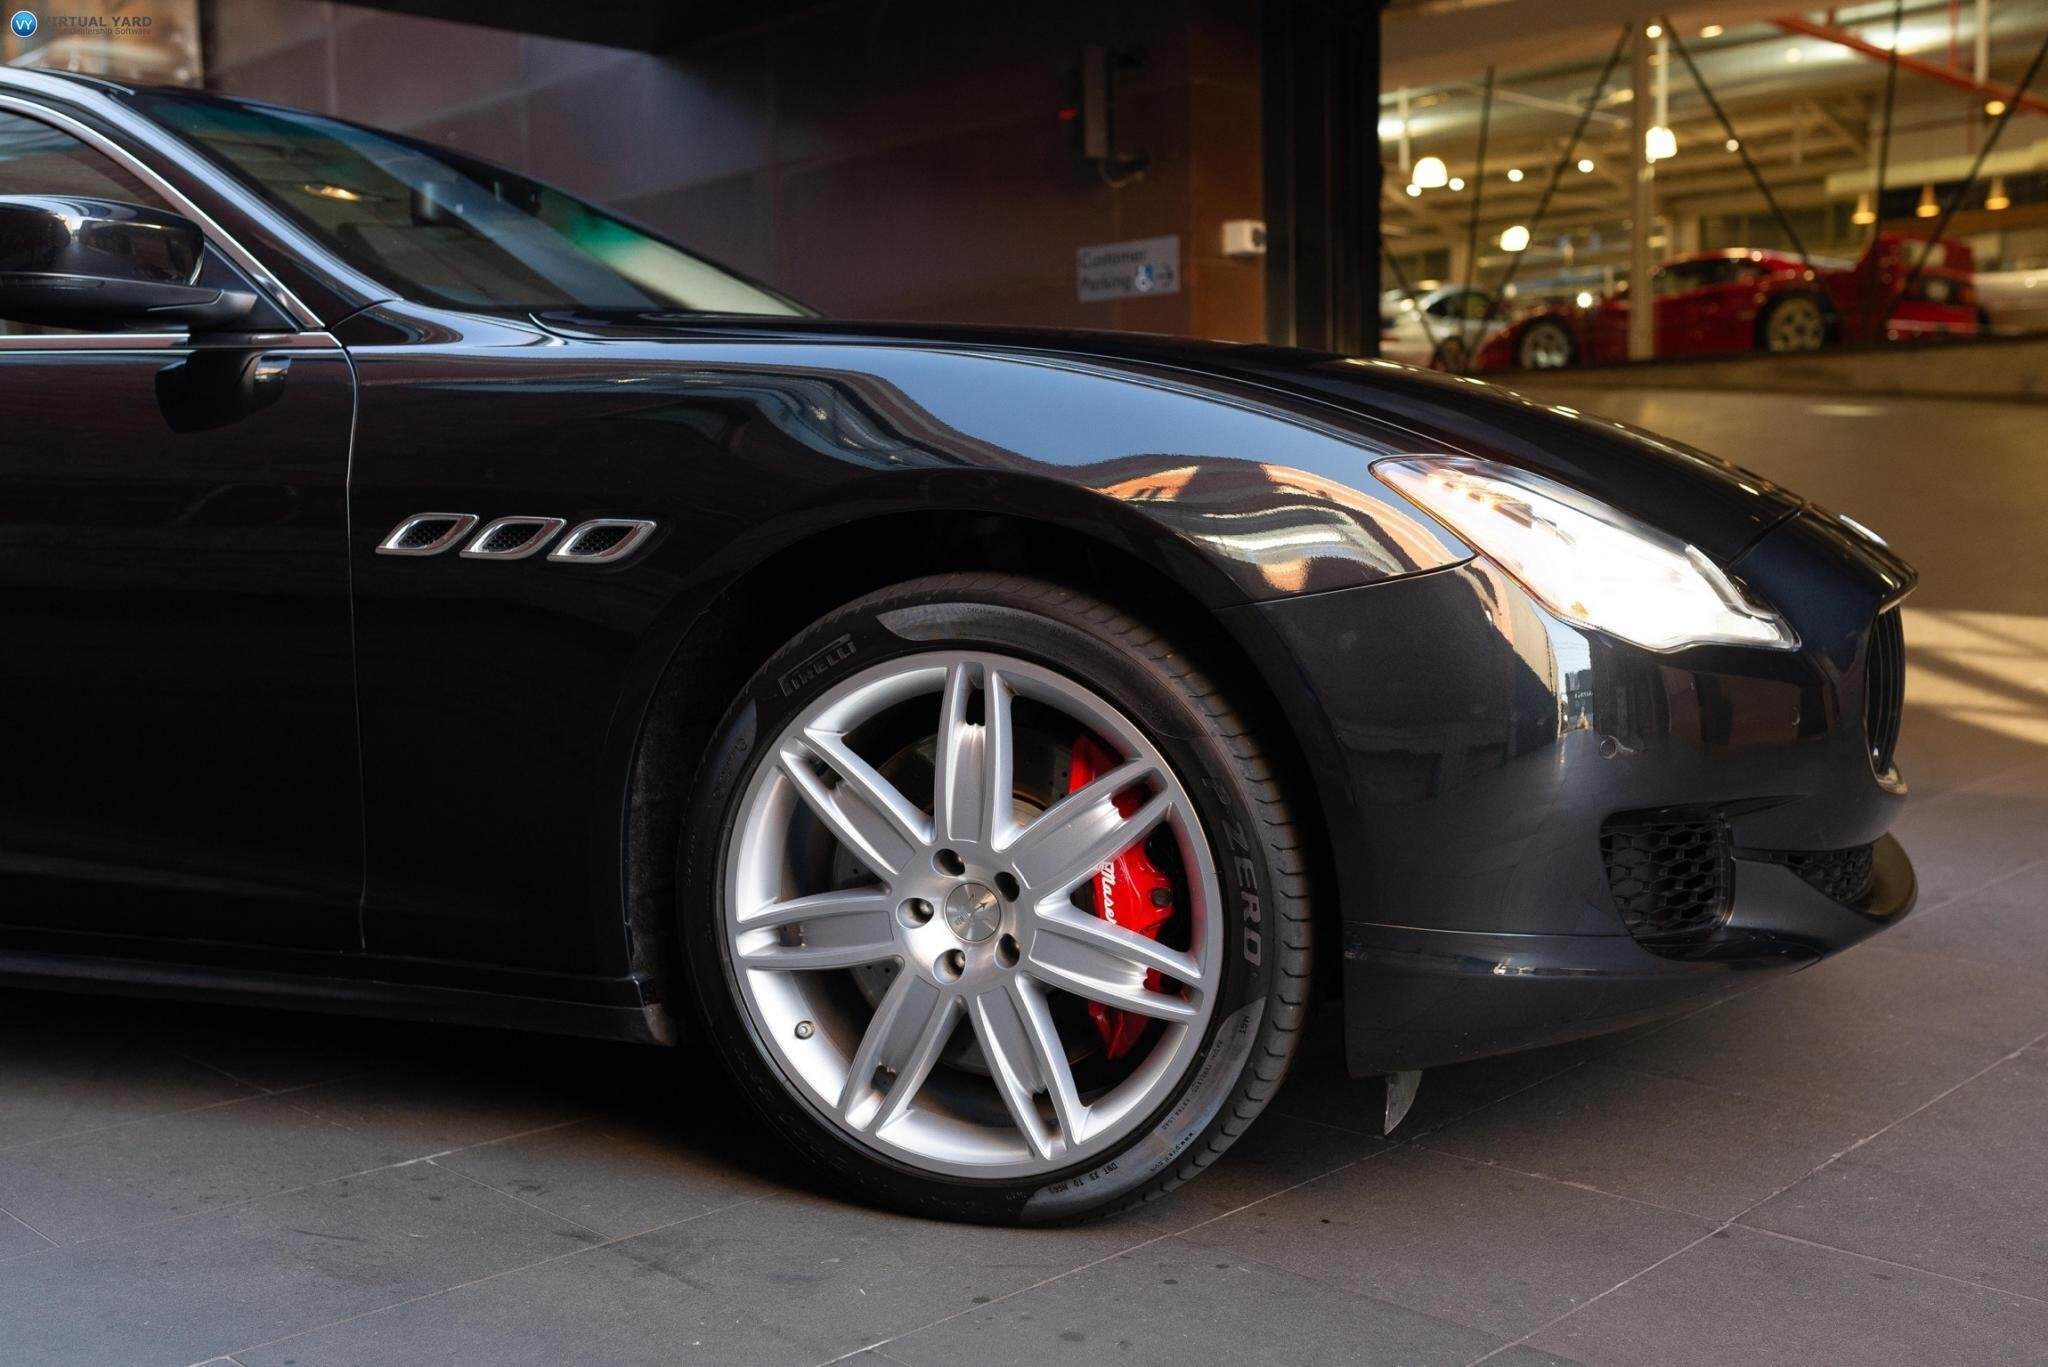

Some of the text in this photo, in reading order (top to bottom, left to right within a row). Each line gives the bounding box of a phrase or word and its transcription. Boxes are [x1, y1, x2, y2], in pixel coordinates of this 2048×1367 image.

[1082, 250, 1147, 268] Customer
[1082, 275, 1132, 292] Parking
[778, 633, 856, 697] PIRELLI
[1222, 819, 1262, 967] ZERO
